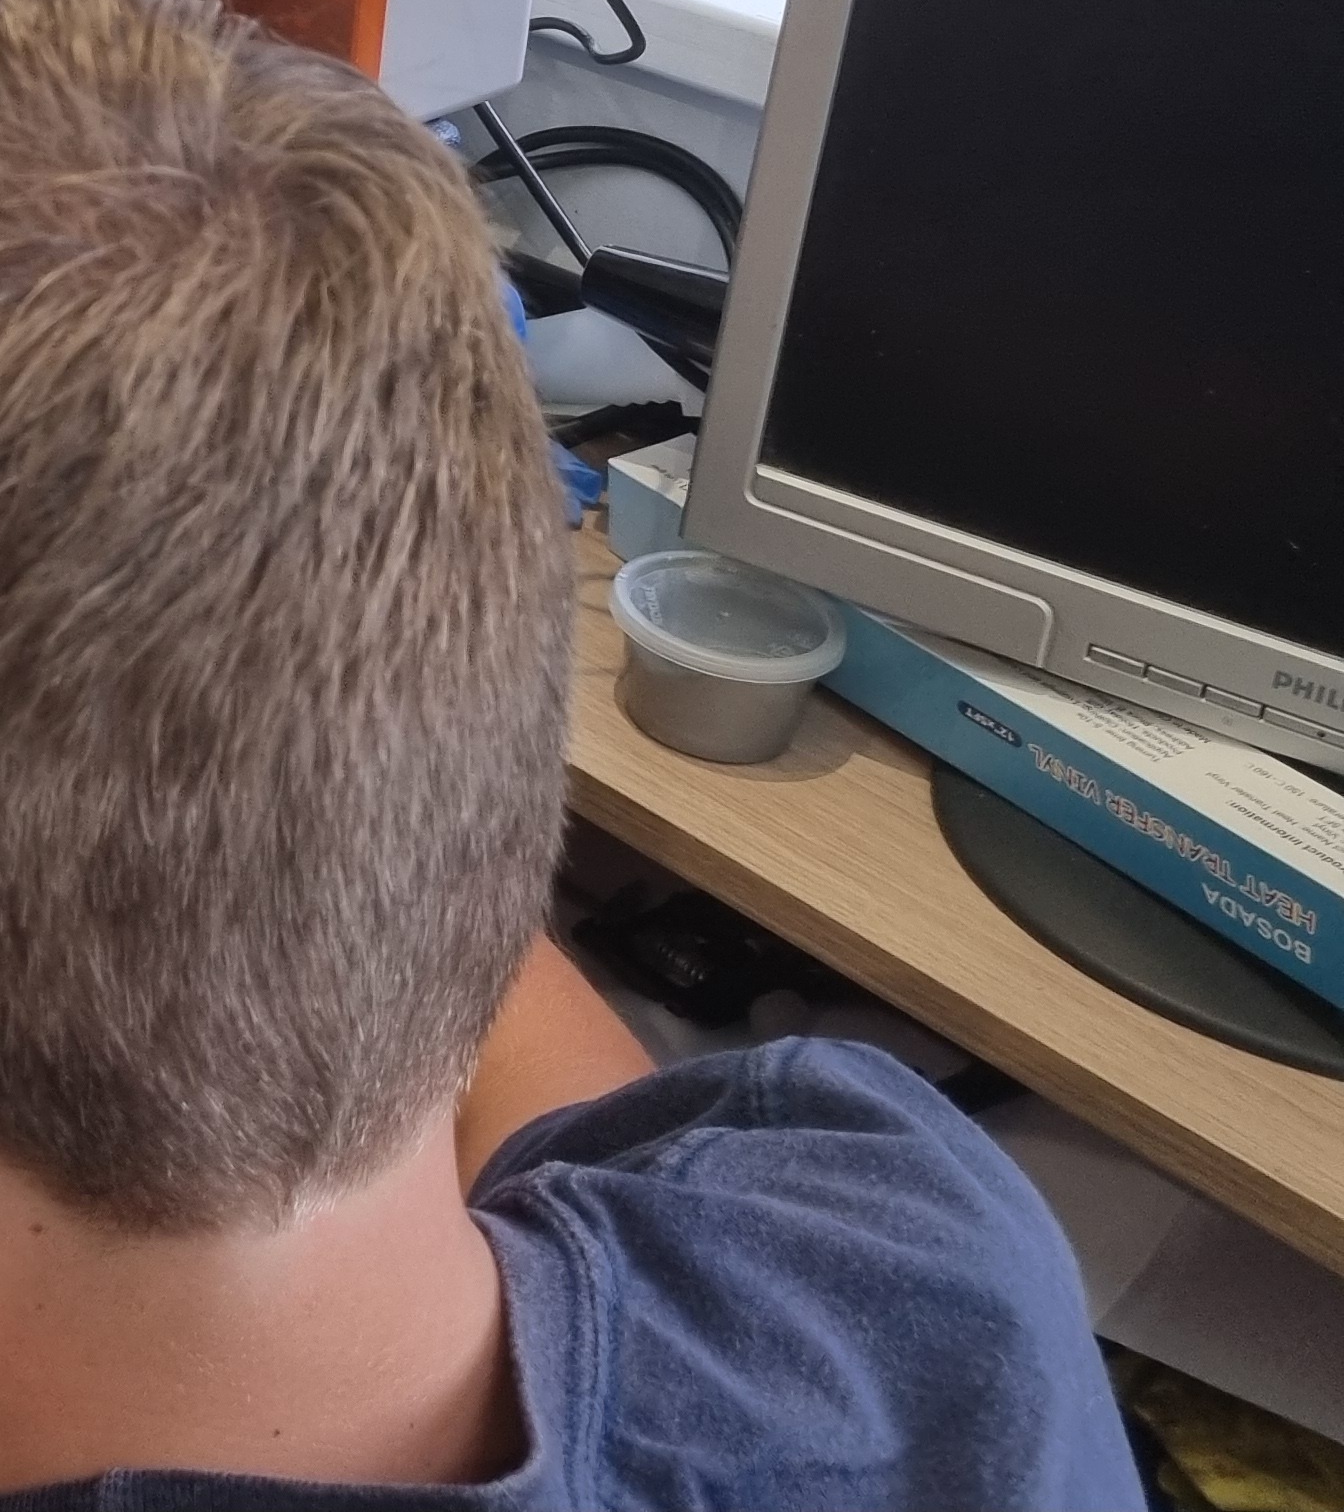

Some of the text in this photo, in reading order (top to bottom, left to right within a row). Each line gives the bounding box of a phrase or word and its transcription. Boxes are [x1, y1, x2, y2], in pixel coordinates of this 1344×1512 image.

[1027, 742, 1101, 806] VINYL
[1204, 771, 1231, 788] Vinyl
[1230, 786, 1273, 811] Transfer
[1105, 788, 1237, 886] TRANSFER
[1201, 882, 1314, 965] BOSADA
[1239, 874, 1317, 936] HEAT
